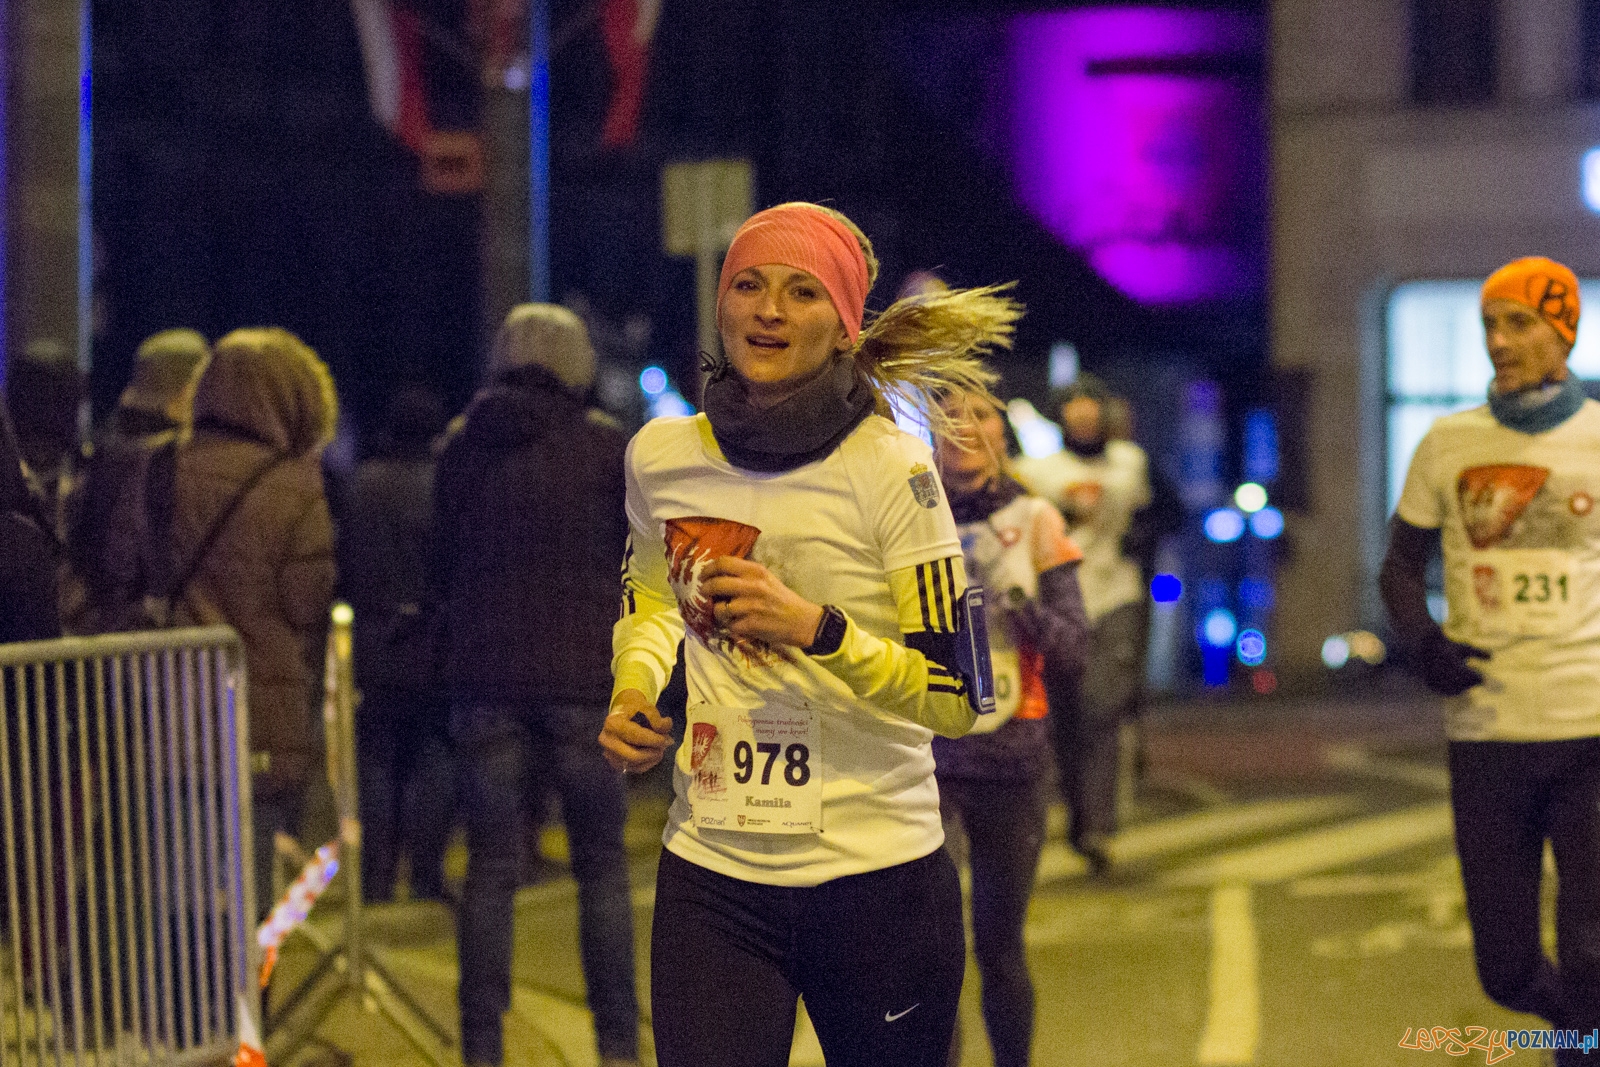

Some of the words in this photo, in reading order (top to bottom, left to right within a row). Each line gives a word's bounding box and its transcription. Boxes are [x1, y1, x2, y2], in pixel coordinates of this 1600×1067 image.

[1514, 573, 1568, 602] 231
[733, 740, 811, 787] 978
[745, 796, 792, 808] Kamila
